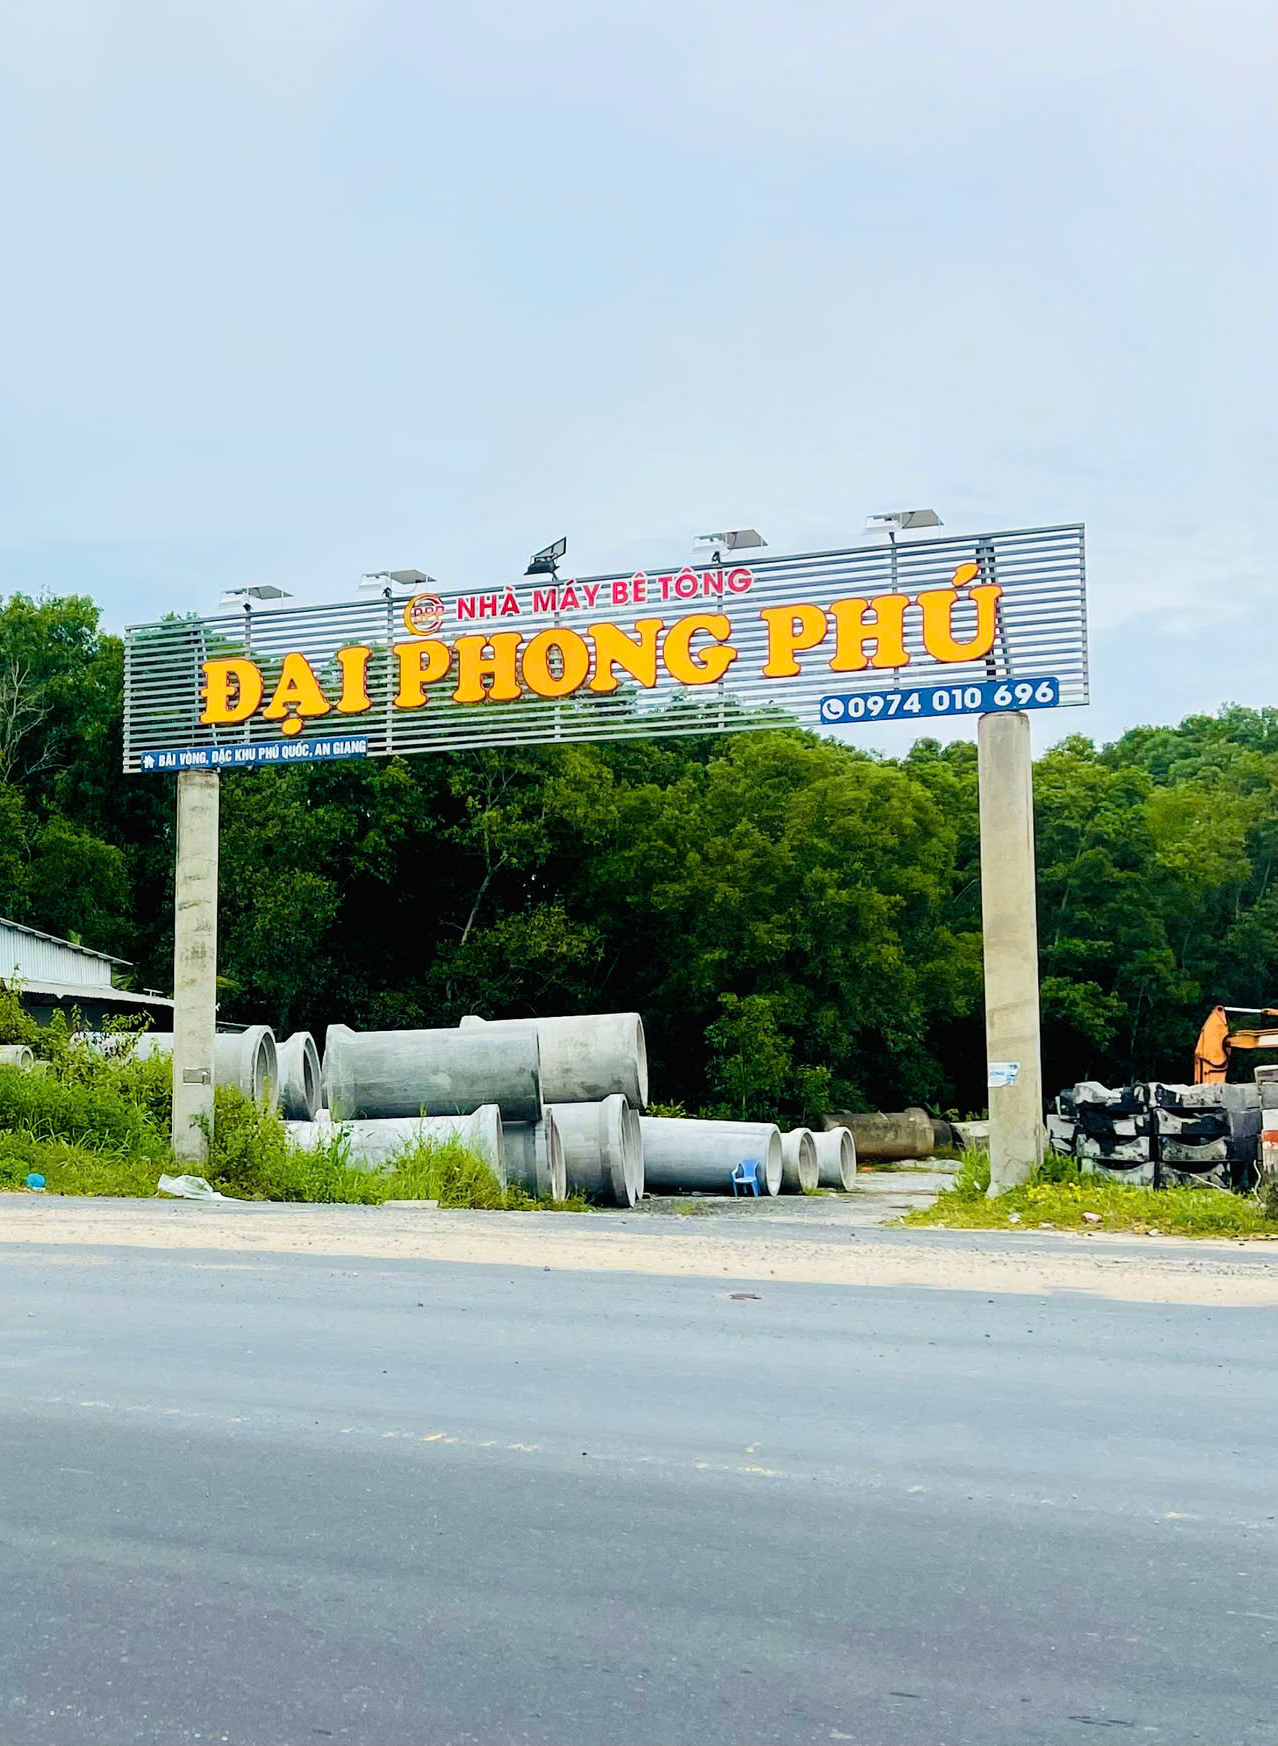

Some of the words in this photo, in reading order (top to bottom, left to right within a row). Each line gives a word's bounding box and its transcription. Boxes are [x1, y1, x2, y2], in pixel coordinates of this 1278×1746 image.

[457, 585, 520, 620] NHÀ
[533, 579, 600, 613] MÁY
[612, 572, 647, 605] BÊ
[658, 568, 753, 600] TÔNG
[199, 646, 374, 737] ĐẠI
[392, 613, 738, 711] PHONG
[760, 562, 1003, 679] PHÚ
[848, 692, 922, 718] 0974
[932, 687, 982, 711] 010
[994, 681, 1054, 706] 696
[158, 751, 176, 767] BÃI
[179, 750, 209, 765] VÒNG,
[235, 748, 256, 762] KHU
[258, 744, 279, 760] PHÚ
[282, 741, 313, 759] QUỐC,
[314, 743, 331, 756] AN
[333, 740, 367, 755] GIANG
